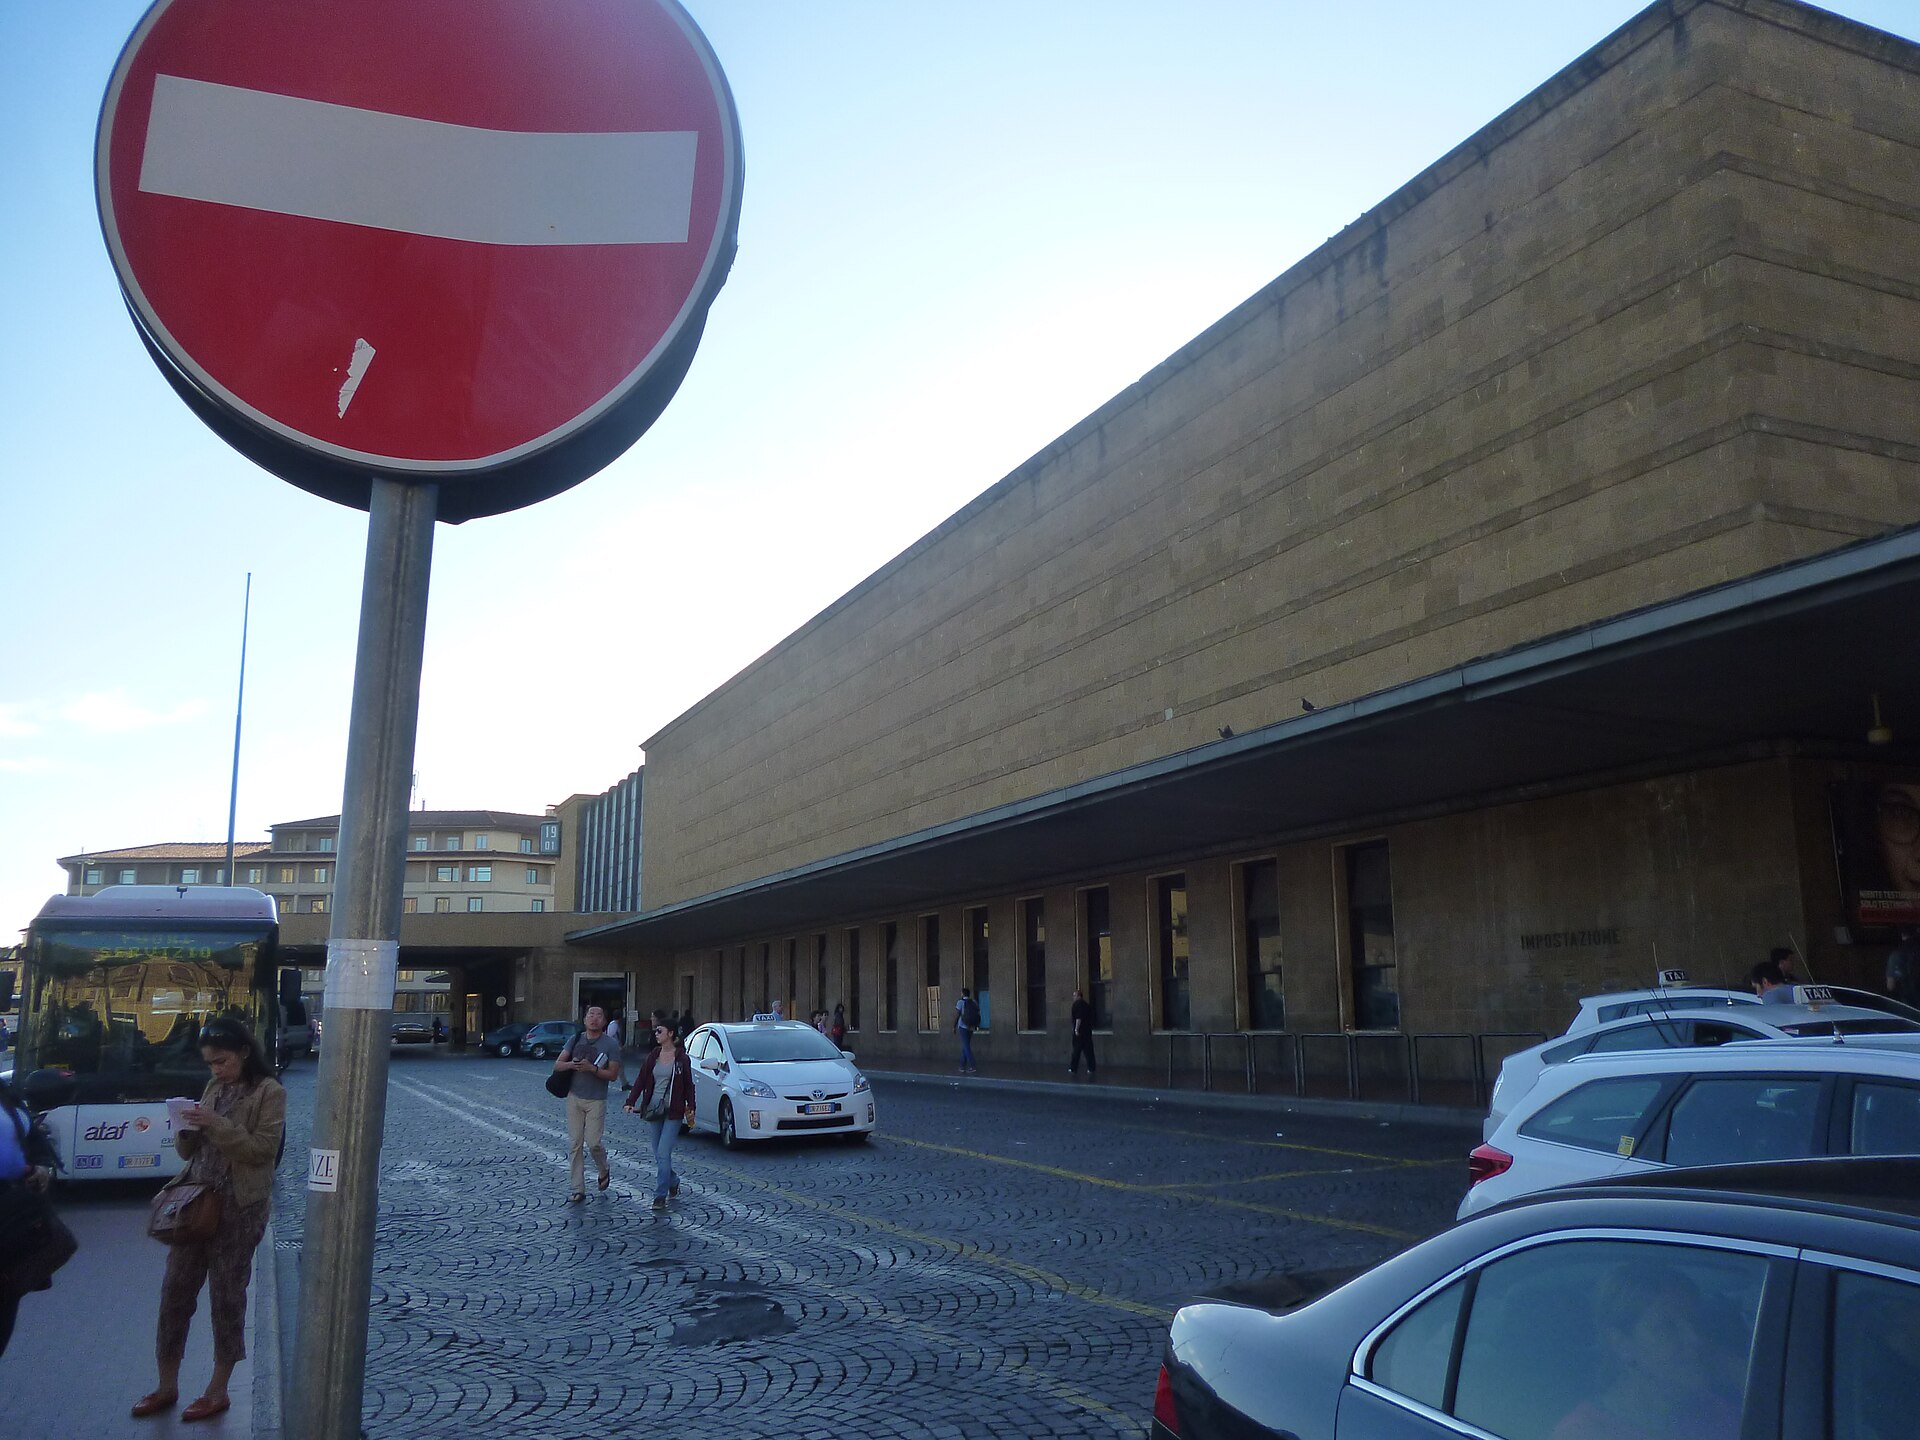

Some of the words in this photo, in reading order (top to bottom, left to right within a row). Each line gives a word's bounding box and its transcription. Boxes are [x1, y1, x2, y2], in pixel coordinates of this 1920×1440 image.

[545, 825, 557, 838] 19
[544, 841, 555, 850] 01
[1520, 928, 1620, 950] IMPOSTAZIONE
[1804, 988, 1832, 999] TAXI
[84, 1121, 129, 1140] ataf
